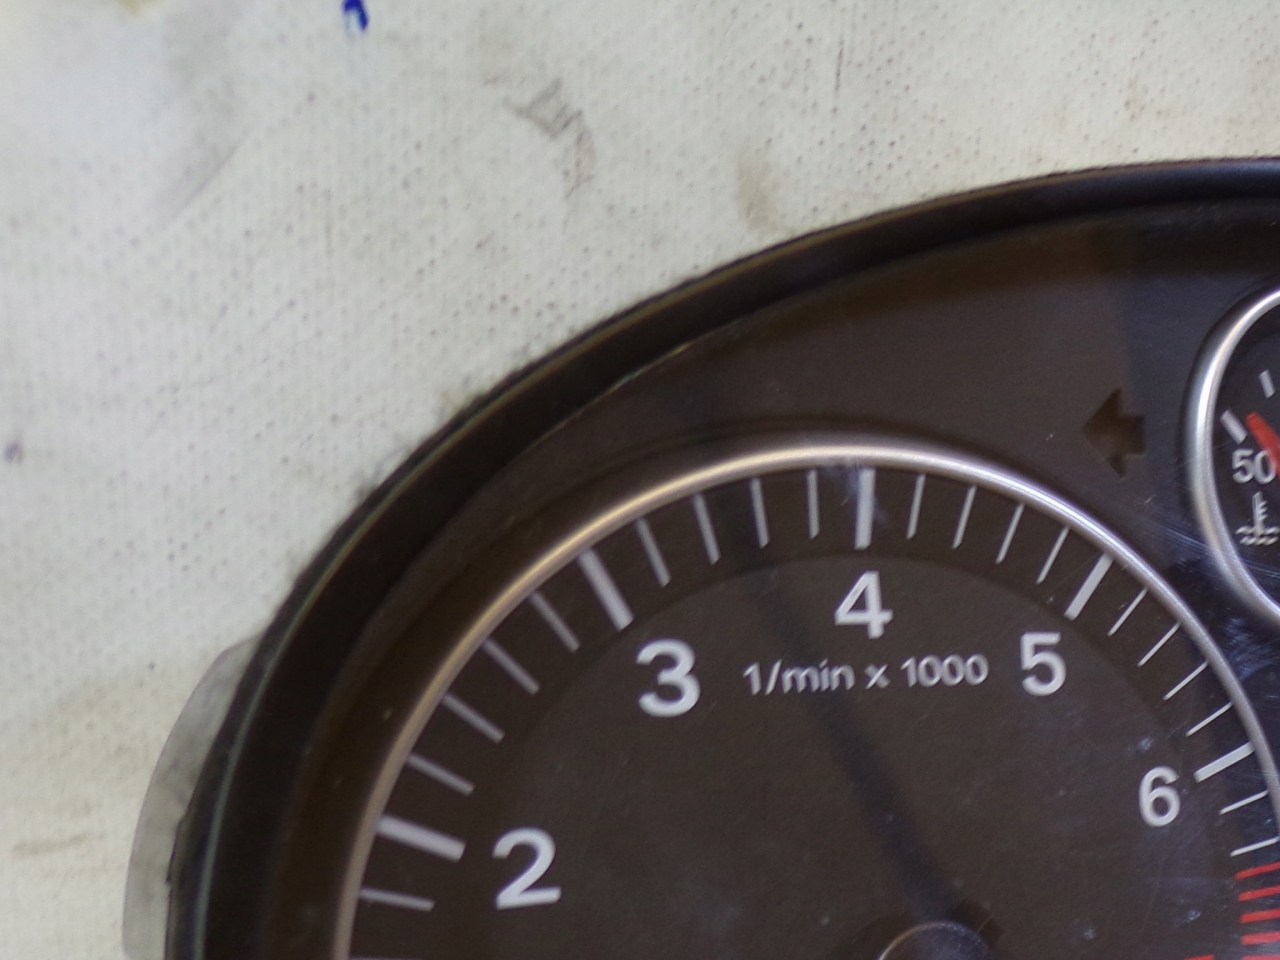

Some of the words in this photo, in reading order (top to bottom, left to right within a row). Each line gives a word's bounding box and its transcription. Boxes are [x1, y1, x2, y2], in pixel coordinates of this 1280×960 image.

[1232, 449, 1276, 484] 50
[834, 570, 893, 639] 4
[636, 639, 700, 717] 3
[742, 660, 855, 697] 1/min
[864, 666, 890, 689] x
[900, 654, 990, 687] 1000
[1019, 632, 1066, 696] 5
[1138, 767, 1182, 827] 6
[492, 828, 562, 910] 2
